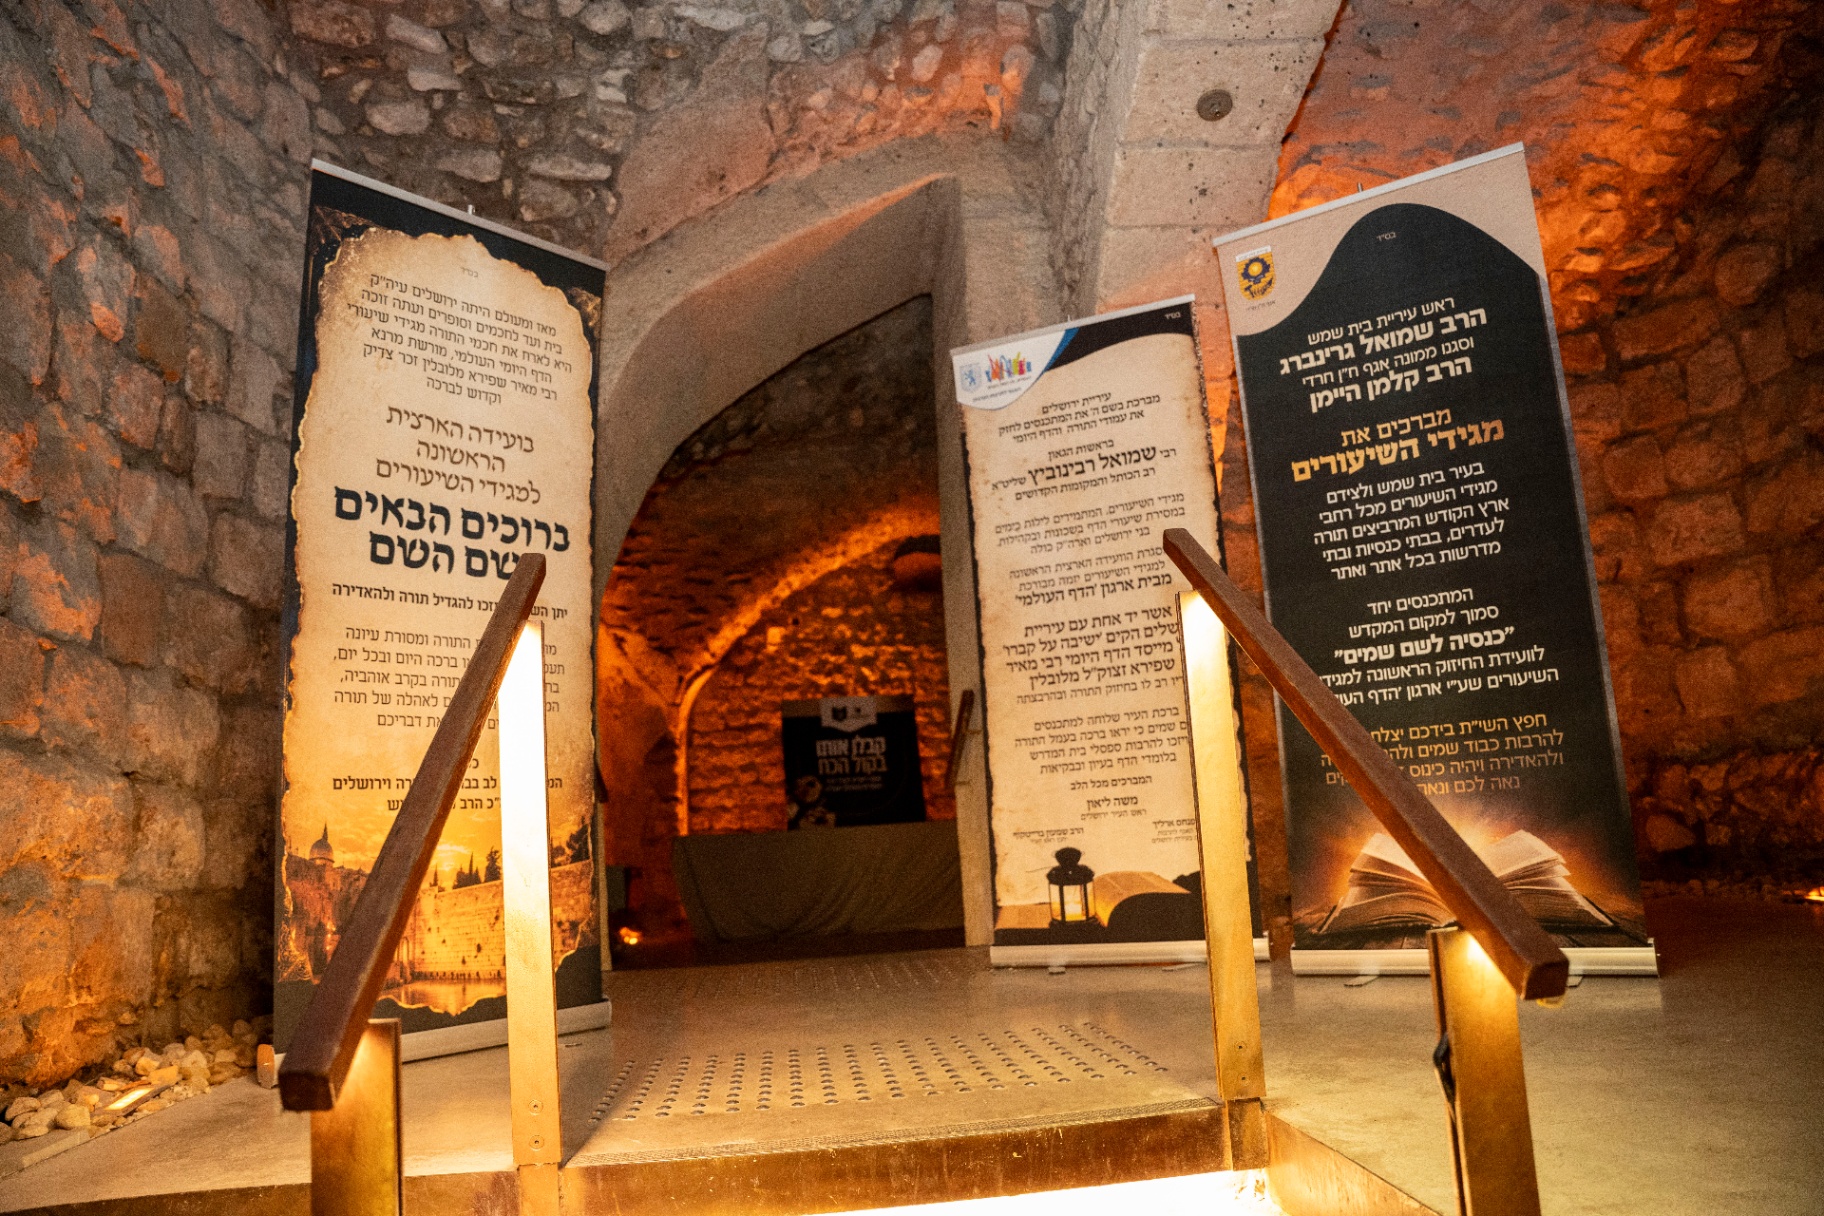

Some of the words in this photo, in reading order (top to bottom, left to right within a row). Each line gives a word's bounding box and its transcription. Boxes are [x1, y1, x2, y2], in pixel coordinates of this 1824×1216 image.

[361, 289, 388, 305] זוכה
[412, 285, 457, 308] ירושלים
[347, 302, 389, 323] שיעורי
[392, 297, 424, 315] ועתה
[461, 301, 491, 318] היתה
[1421, 297, 1455, 316] ראש
[394, 315, 426, 333] מגידי
[428, 308, 472, 330] וסופרים
[495, 310, 533, 330] ומעולם
[1376, 307, 1417, 329] עיריית
[1439, 308, 1487, 335] הרב
[429, 325, 465, 345] התורה
[476, 321, 519, 342] לחכמים
[536, 322, 556, 337] מאז
[1307, 327, 1344, 345] שמש
[1347, 319, 1373, 336] בית
[469, 337, 498, 353] חכמי
[522, 334, 541, 348] ועד
[1359, 321, 1434, 355] שמואל
[1441, 336, 1475, 355] וסגנו
[363, 343, 394, 361] צדיק
[501, 345, 518, 358] את
[544, 340, 562, 355] בית
[398, 351, 418, 366] זכר
[522, 350, 550, 367] לארח
[1279, 342, 1356, 376] גרינברג
[1394, 346, 1437, 367] ממונה
[422, 358, 465, 379] מלובלין
[554, 359, 572, 373] היא
[1362, 358, 1394, 376] אגף
[1425, 356, 1473, 383] הרב
[426, 376, 463, 396] לברכה
[468, 370, 507, 388] שפירא
[1302, 371, 1334, 387] חרדי
[1366, 369, 1420, 401] קלמן
[467, 387, 502, 406] וקדוש
[510, 380, 537, 396] מאיר
[541, 387, 558, 401] רבי
[1041, 399, 1080, 415] ירושלים
[1082, 392, 1112, 407] עיריית
[1309, 383, 1362, 414] היימן
[386, 405, 464, 439] הארצית
[1376, 408, 1452, 439] מברכים
[468, 425, 535, 454] בועידה
[1340, 426, 1371, 447] את
[1427, 419, 1505, 451] מגידי
[416, 439, 506, 473] הראשונה
[1098, 446, 1157, 469] שמואל
[1159, 448, 1177, 458] רבי
[1291, 438, 1420, 482] השיעורים
[376, 458, 474, 493] השיעורים
[1027, 459, 1096, 486] רבינוביץ
[1109, 469, 1141, 483] הכותל
[1142, 467, 1156, 478] רב
[1418, 470, 1446, 487] בית
[1448, 462, 1485, 479] בעיר
[479, 478, 541, 505] למגידי
[1014, 485, 1058, 501] הקדושים
[1060, 476, 1108, 493] והמקומות
[1326, 482, 1373, 504] ולצידם
[1377, 476, 1415, 495] שמש
[1460, 479, 1498, 496] מגידי
[1390, 488, 1457, 512] השיעורים
[1477, 497, 1510, 517] ארץ
[334, 485, 451, 536] הבאים
[1319, 508, 1353, 524] רחבי
[1355, 502, 1387, 518] מכל
[1425, 504, 1474, 525] הקודש
[460, 507, 570, 552] ברוכים
[1352, 515, 1421, 538] המרביצים
[1313, 528, 1348, 545] תורה
[1405, 531, 1442, 548] בבתי
[369, 530, 455, 575] השם
[1322, 546, 1352, 562] ובתי
[1355, 538, 1402, 557] כנסיות
[1439, 541, 1502, 563] מדרשות
[464, 546, 519, 580] שם
[1370, 558, 1402, 574] אתר
[1404, 552, 1436, 569] בכל
[1330, 564, 1367, 580] ואתר
[1100, 579, 1135, 599] ארגון
[1137, 573, 1172, 590] מבית
[332, 582, 395, 601] ולהאדירה
[399, 590, 429, 605] תורה
[1396, 587, 1474, 612] המתכנסים
[432, 592, 474, 610] להגדיל
[1366, 600, 1392, 615] יחד
[551, 607, 568, 621] יתן
[1091, 613, 1122, 629] אחת
[1124, 611, 1138, 623] יד
[1141, 605, 1173, 620] אשר
[1408, 608, 1456, 631] למקום
[1460, 605, 1500, 625] סמוך
[1024, 621, 1065, 638] עיריית
[1068, 618, 1088, 632] עם
[1348, 619, 1405, 639] המקדש
[345, 626, 380, 642] עיונה
[384, 630, 429, 645] ומסורת
[433, 635, 470, 648] התורה
[1133, 641, 1174, 656] מייסד
[1400, 633, 1444, 657] לשם
[362, 647, 391, 663] ובכל
[396, 652, 423, 665] היום
[427, 654, 458, 668] ברכה
[1040, 656, 1062, 669] רבי
[1065, 651, 1100, 665] היומי
[1103, 647, 1131, 663] הדף
[1488, 644, 1545, 667] לוועידת
[1005, 659, 1038, 673] מאיר
[1130, 658, 1175, 675] שפירא
[1366, 662, 1432, 682] הראשונה
[1435, 656, 1484, 677] החיזוק
[1029, 669, 1080, 691] מלובלין
[1487, 668, 1560, 689] השיעורים
[334, 690, 367, 704] תורה
[372, 690, 392, 705] של
[396, 691, 438, 707] לאהלה
[1406, 682, 1442, 702] ארגון
[1512, 713, 1548, 732] חפץ
[1408, 723, 1455, 740] בידכם
[1504, 729, 1564, 750] להרבות
[1417, 742, 1459, 758] שמים
[1463, 738, 1500, 753] כבוד
[1450, 759, 1485, 774] ויהיה
[1489, 751, 1564, 771] ולהאדירה
[1409, 763, 1445, 778] כינוס
[1070, 780, 1089, 791] הלב
[1089, 779, 1110, 789] מכל
[1110, 775, 1153, 787] המברכים
[1086, 796, 1111, 811] ליאון
[1113, 796, 1139, 806] משה
